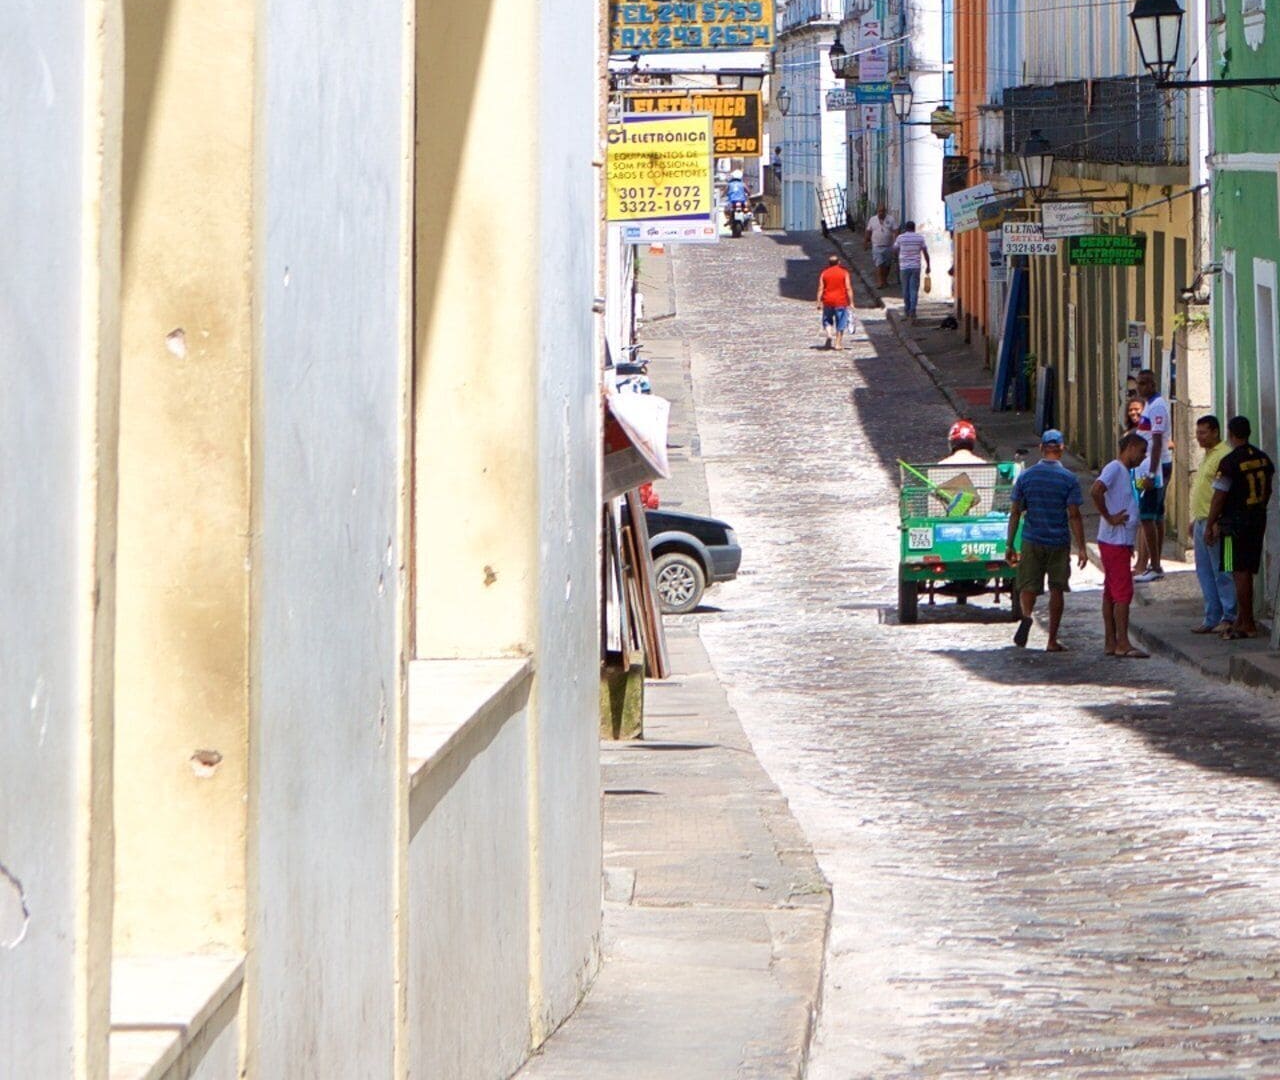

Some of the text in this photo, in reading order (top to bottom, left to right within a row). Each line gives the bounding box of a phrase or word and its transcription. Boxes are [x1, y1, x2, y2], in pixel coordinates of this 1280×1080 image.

[656, 2, 698, 23] 241
[702, 1, 762, 22] 5759
[656, 25, 703, 47] 243
[708, 23, 770, 46] 2634
[614, 150, 698, 161] EQUIPAMENTOS DE
[613, 160, 699, 170] SOM PROFISSIONAL
[647, 169, 708, 179] CONECTORES
[620, 185, 701, 200] 3017-7072
[620, 199, 701, 213] 3322-1697
